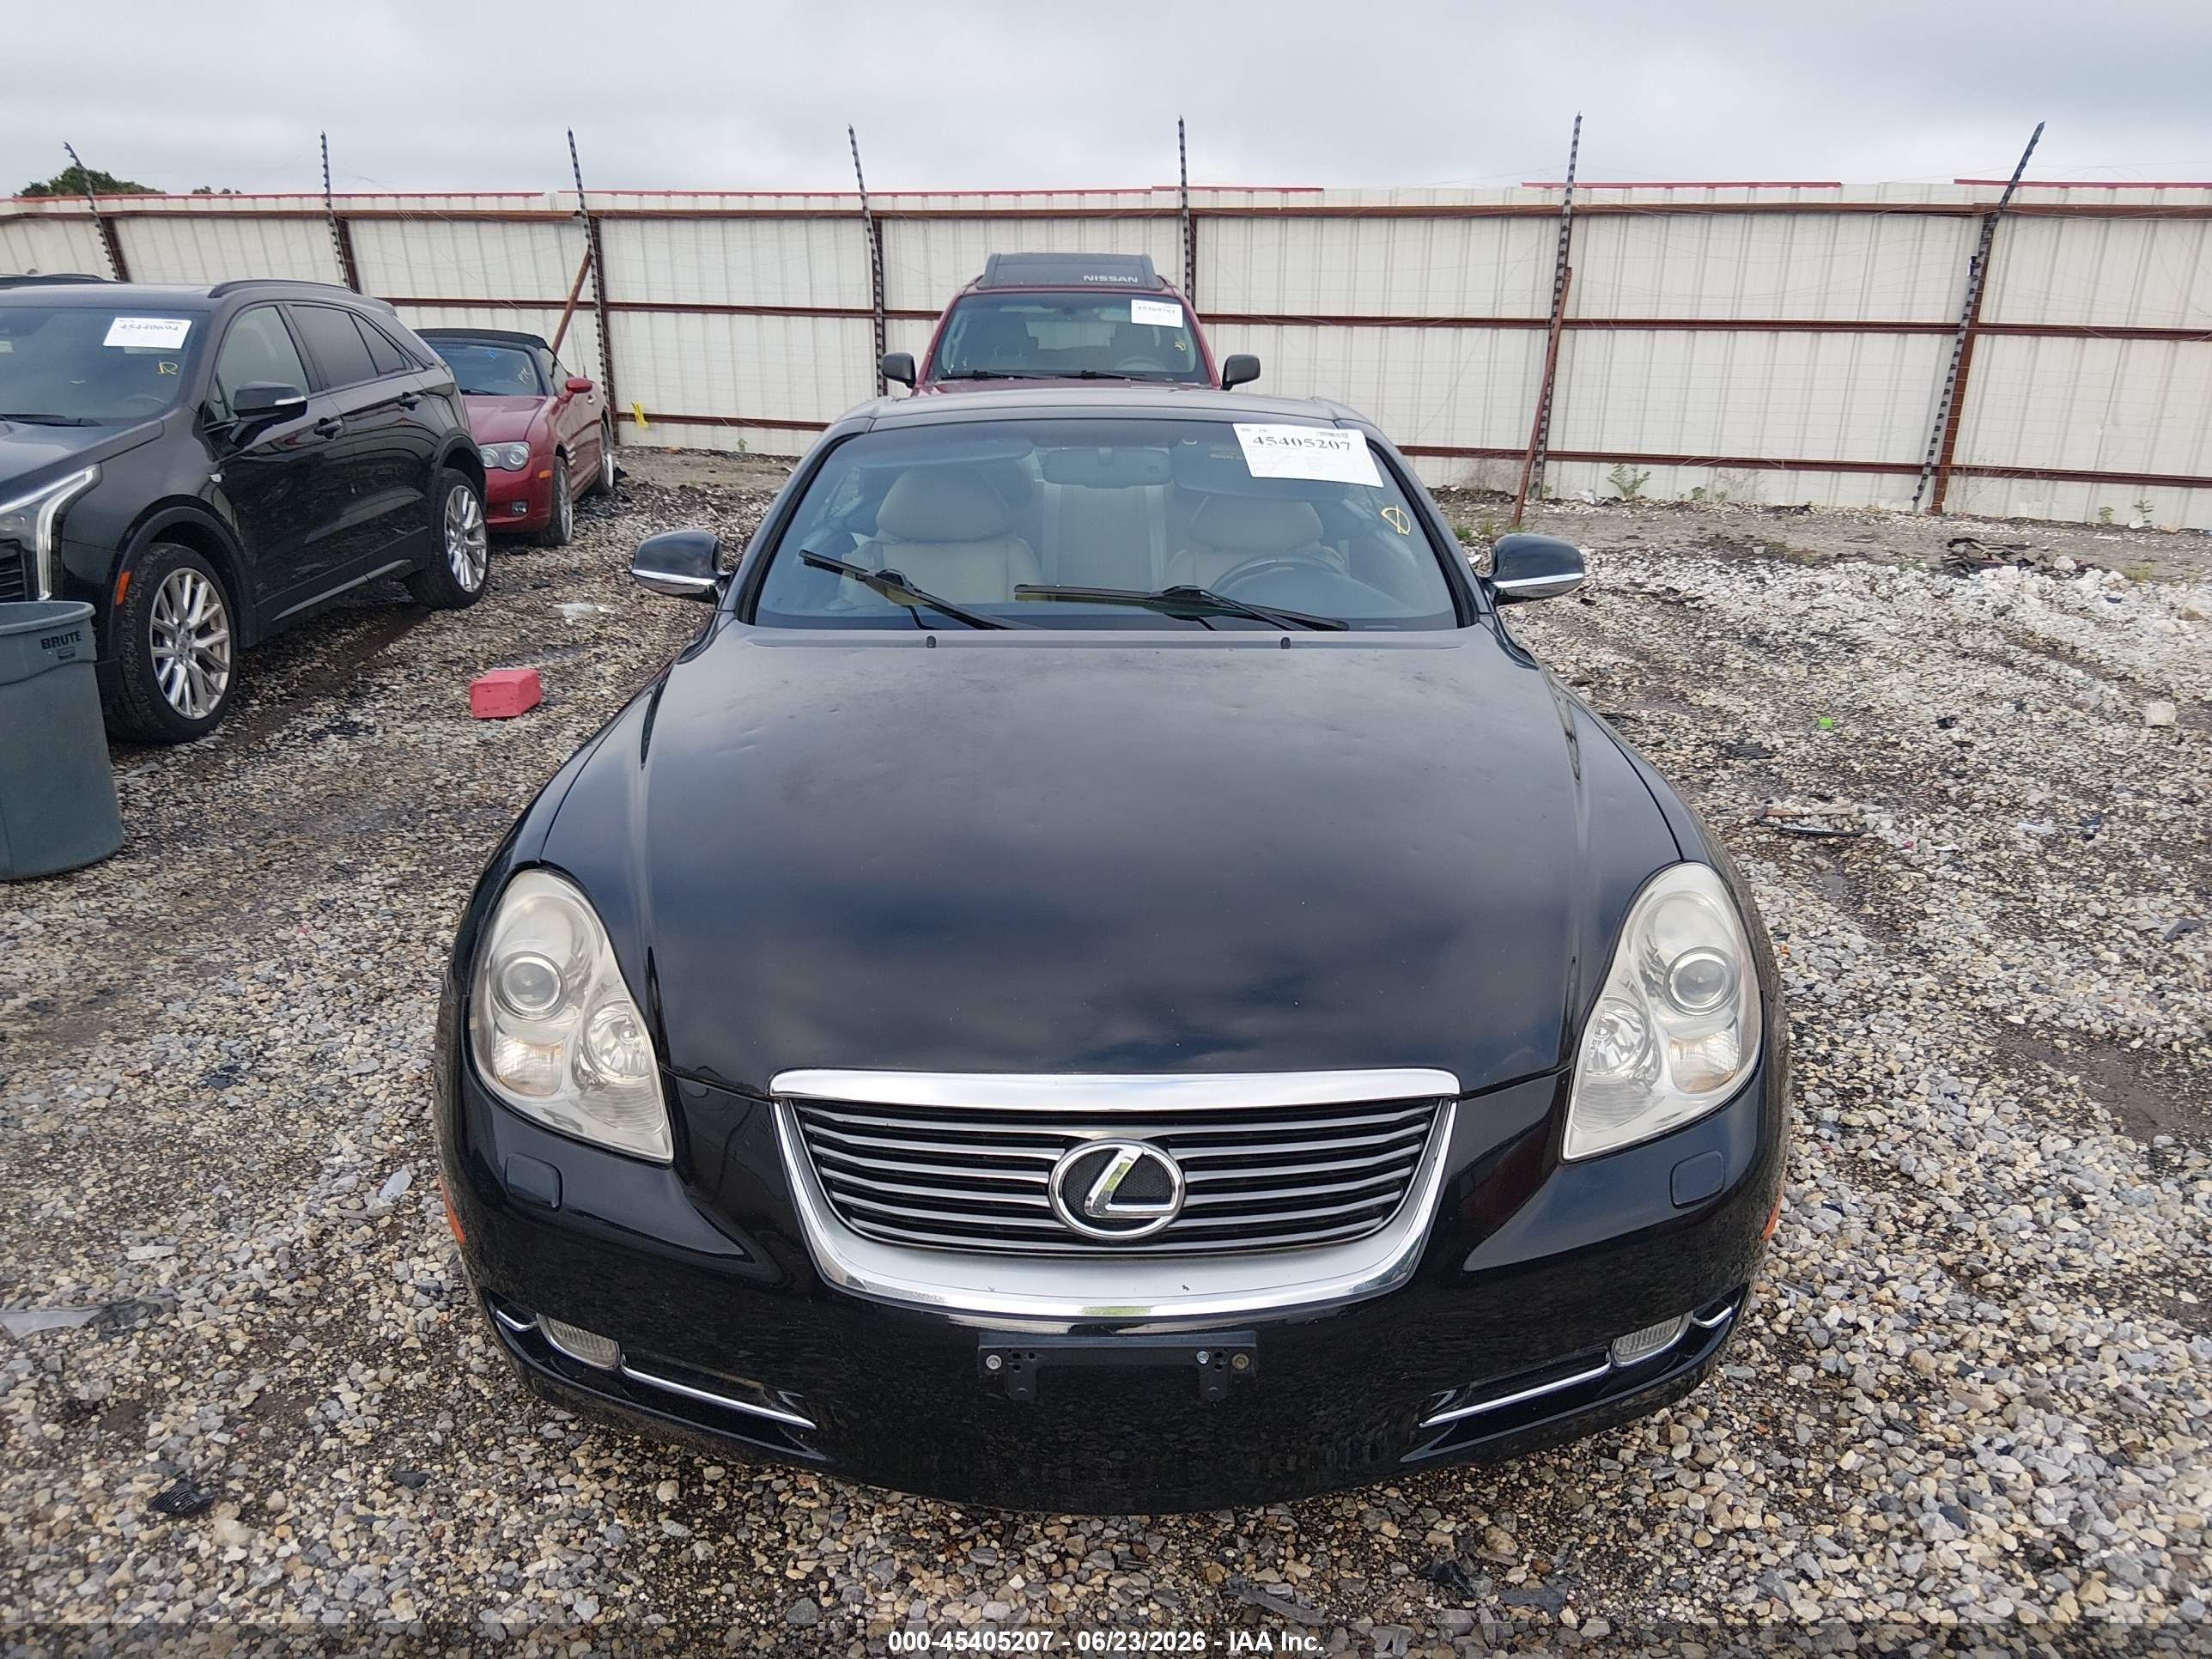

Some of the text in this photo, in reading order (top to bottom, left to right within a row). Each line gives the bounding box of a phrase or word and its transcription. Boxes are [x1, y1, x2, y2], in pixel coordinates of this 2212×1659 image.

[1083, 274, 1139, 283] NISSAN
[1252, 435, 1352, 452] 45405207
[40, 630, 82, 650] BRUTE
